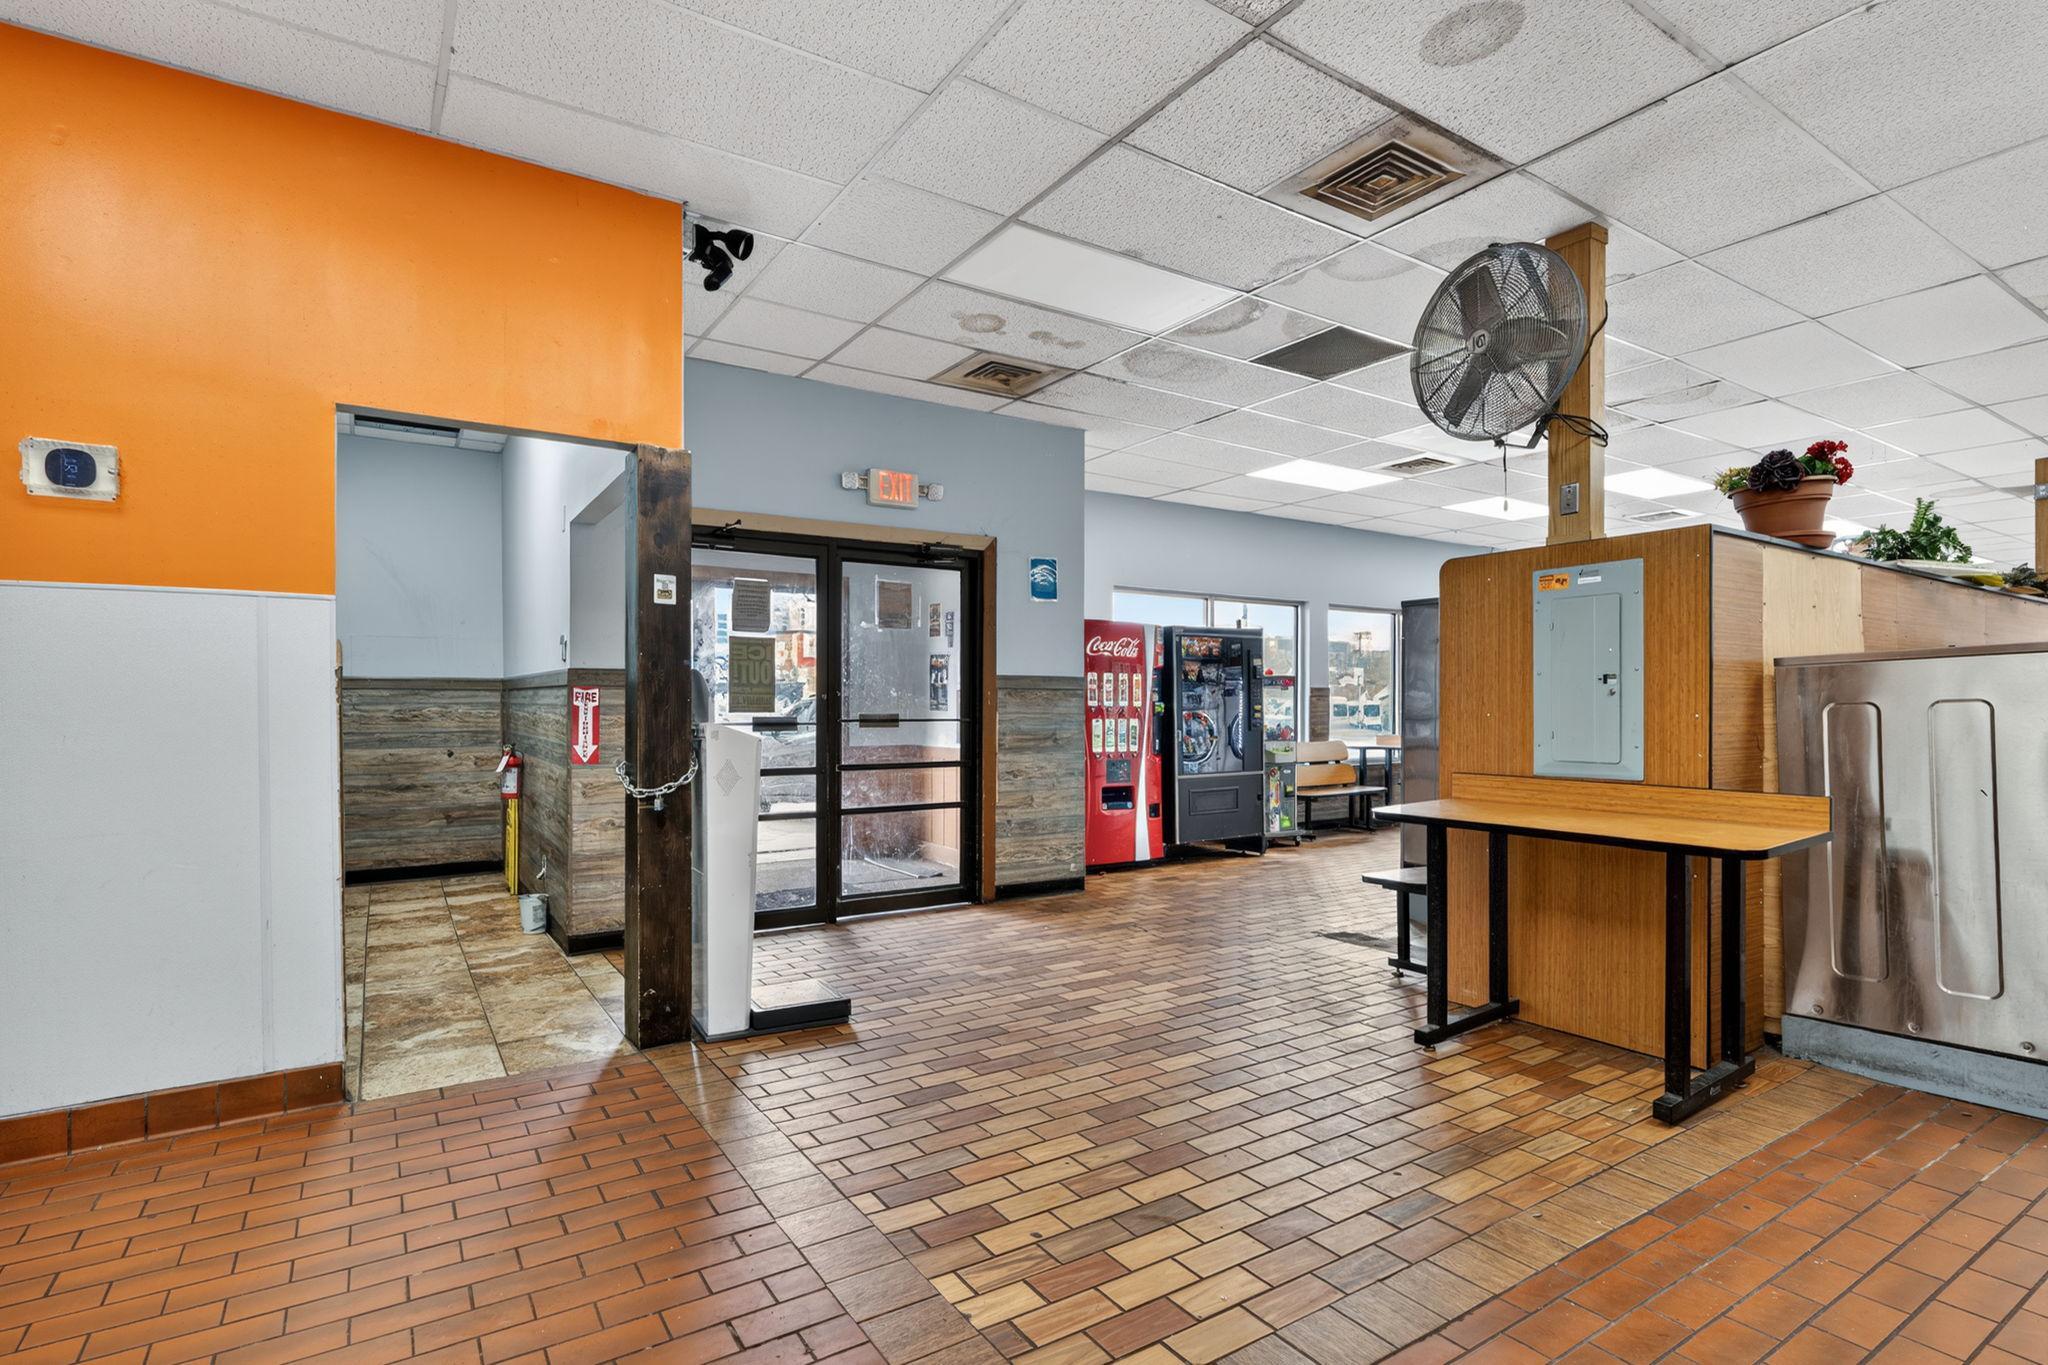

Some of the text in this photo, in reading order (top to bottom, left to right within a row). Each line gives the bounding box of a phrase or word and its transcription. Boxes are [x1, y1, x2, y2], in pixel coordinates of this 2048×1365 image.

[879, 471, 913, 502] EXIT
[1086, 636, 1140, 657] Coca-Cola
[575, 692, 597, 703] FIRE
